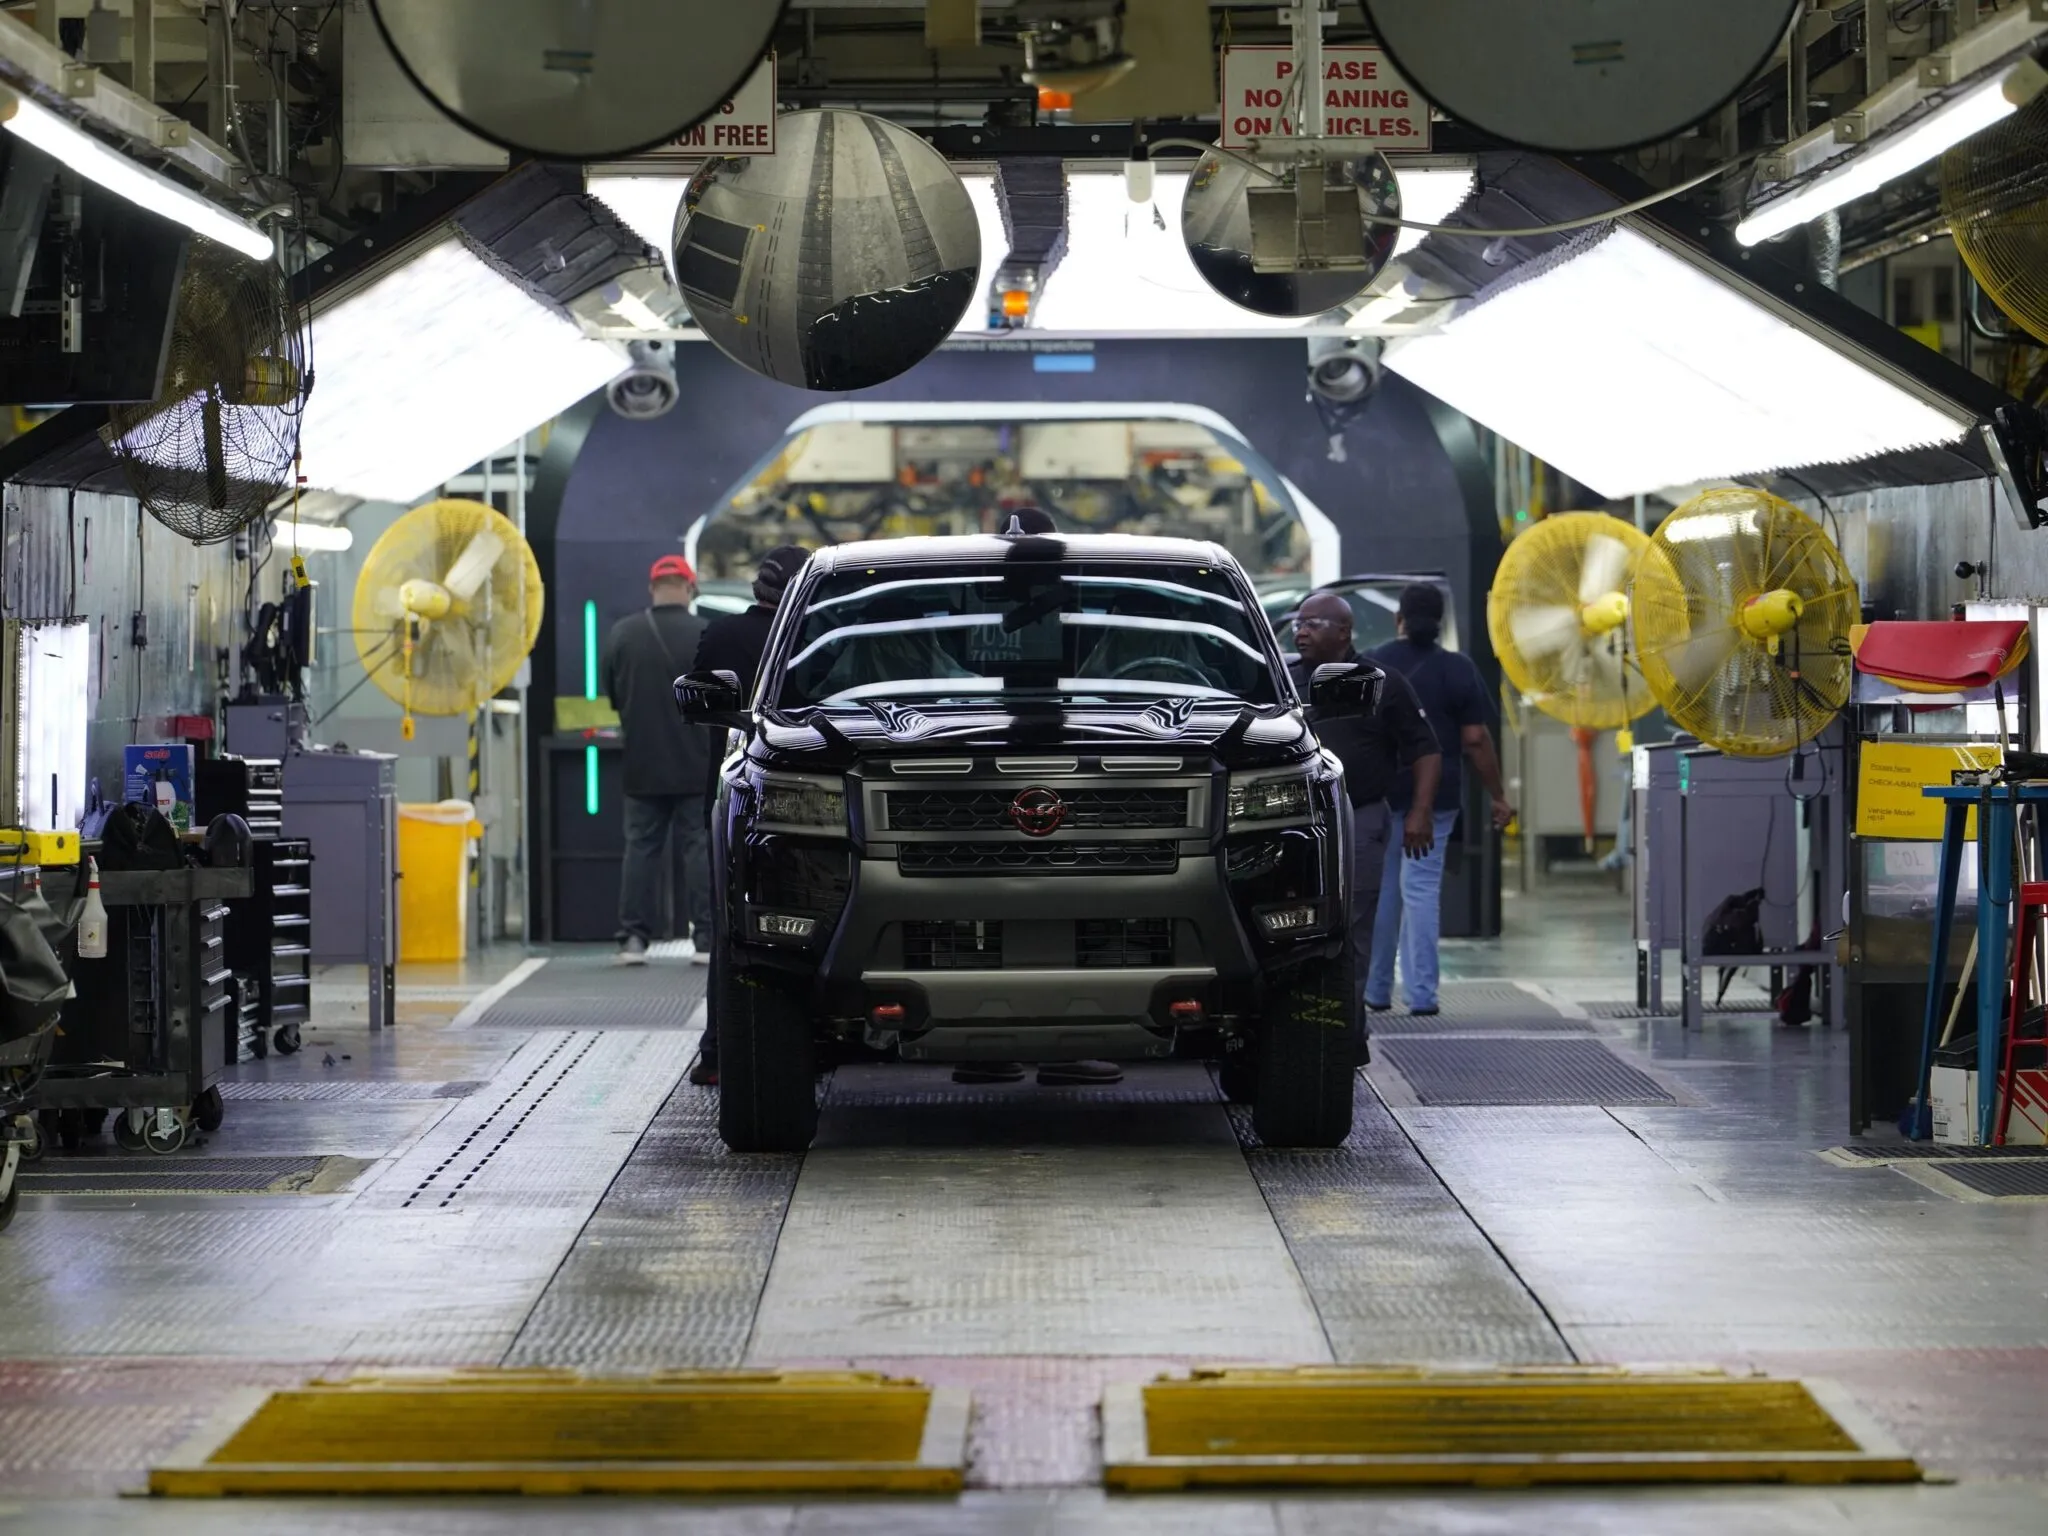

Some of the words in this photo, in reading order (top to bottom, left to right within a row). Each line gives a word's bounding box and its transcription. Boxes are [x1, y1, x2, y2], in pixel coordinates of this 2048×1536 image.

[1277, 61, 1377, 80] PASE
[1245, 89, 1282, 108] NO
[1292, 89, 1409, 109] ANING
[714, 124, 768, 146] FREE
[1234, 117, 1271, 135] ON
[1009, 805, 1067, 816] NISSAN
